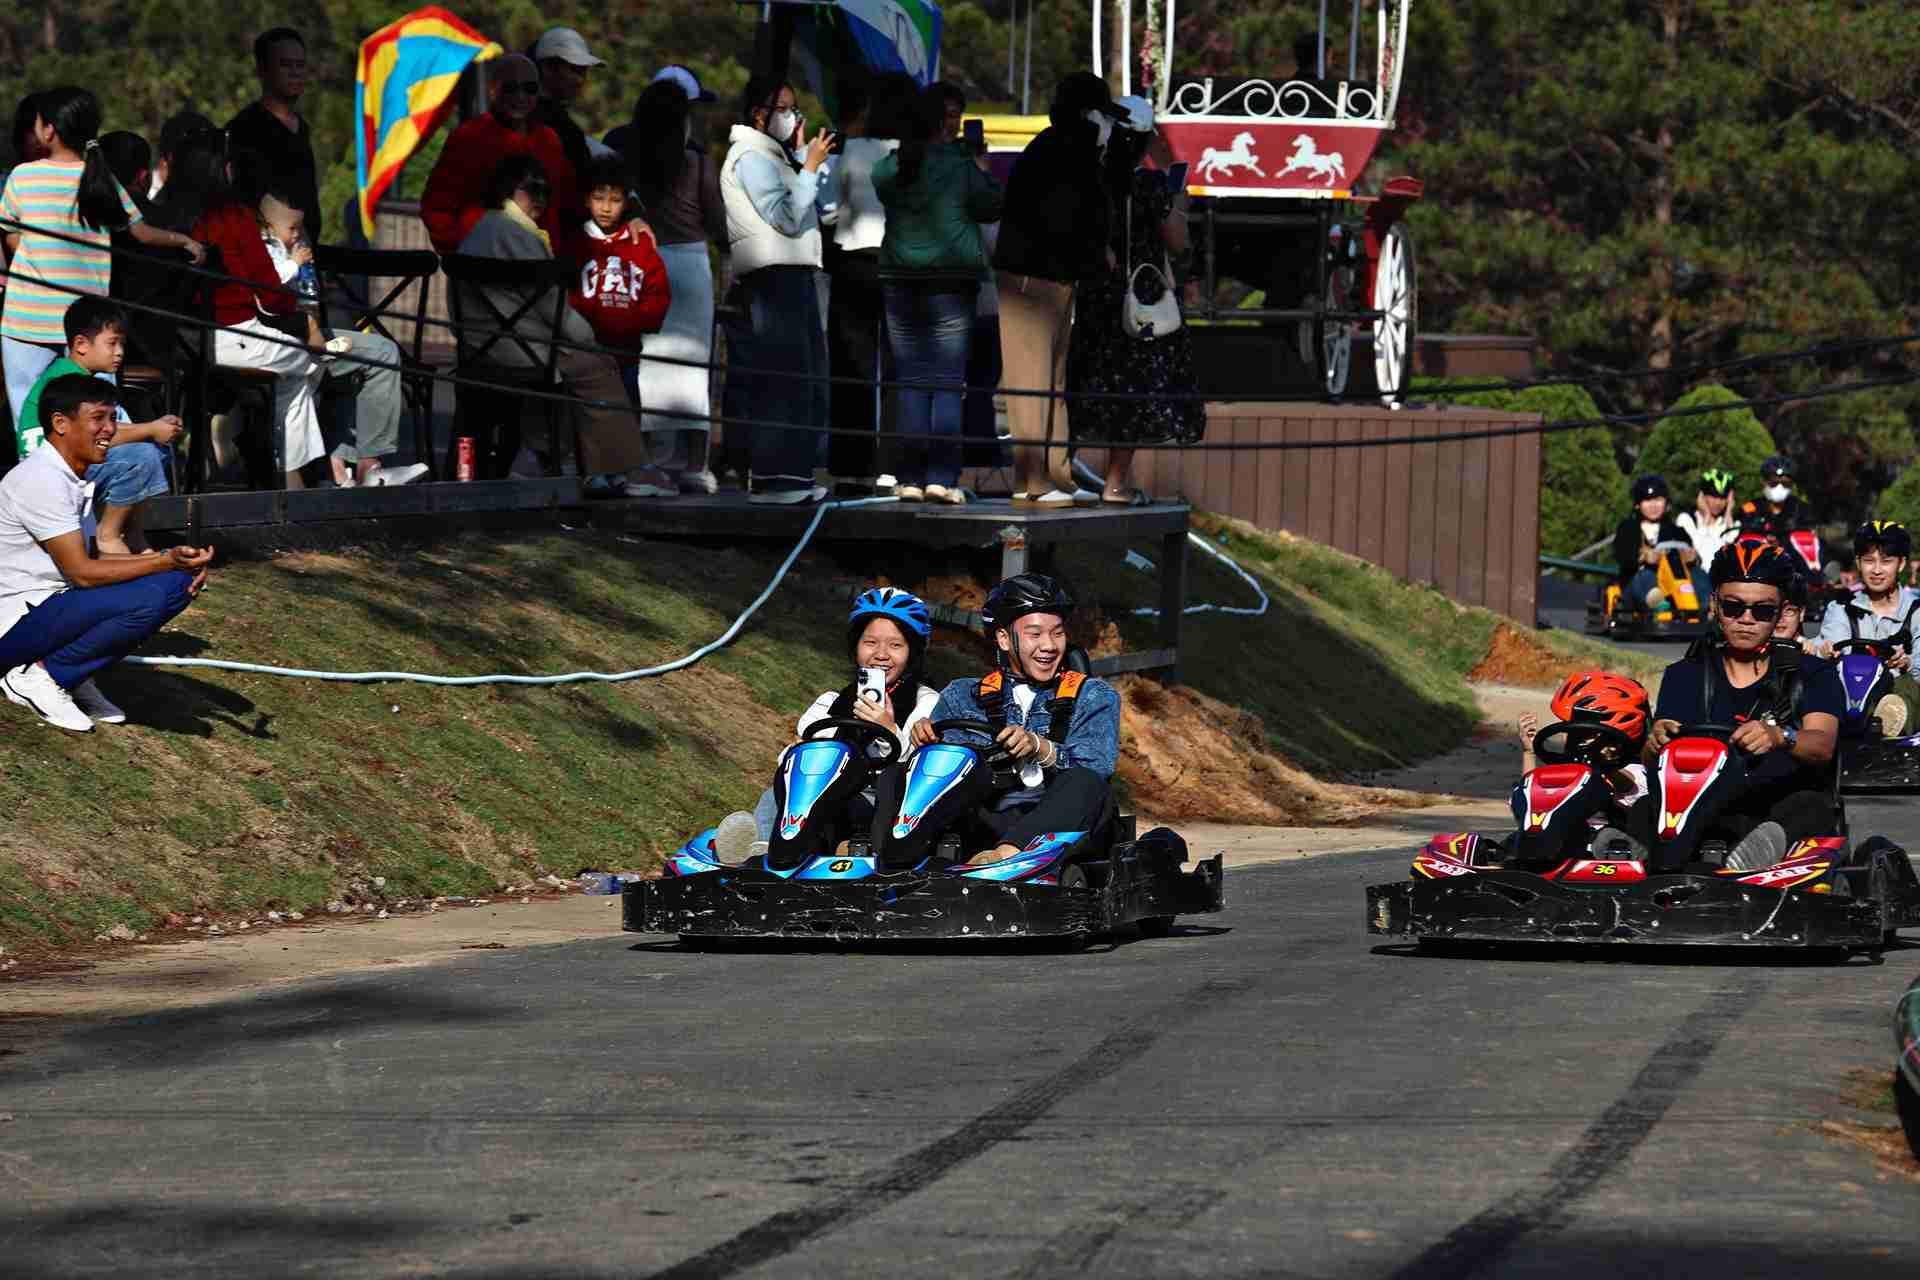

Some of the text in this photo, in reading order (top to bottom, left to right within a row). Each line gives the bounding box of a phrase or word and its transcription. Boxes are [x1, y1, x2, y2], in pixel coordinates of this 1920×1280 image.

[581, 255, 644, 302] GAP
[831, 861, 852, 871] 41
[1592, 864, 1617, 875] 36
